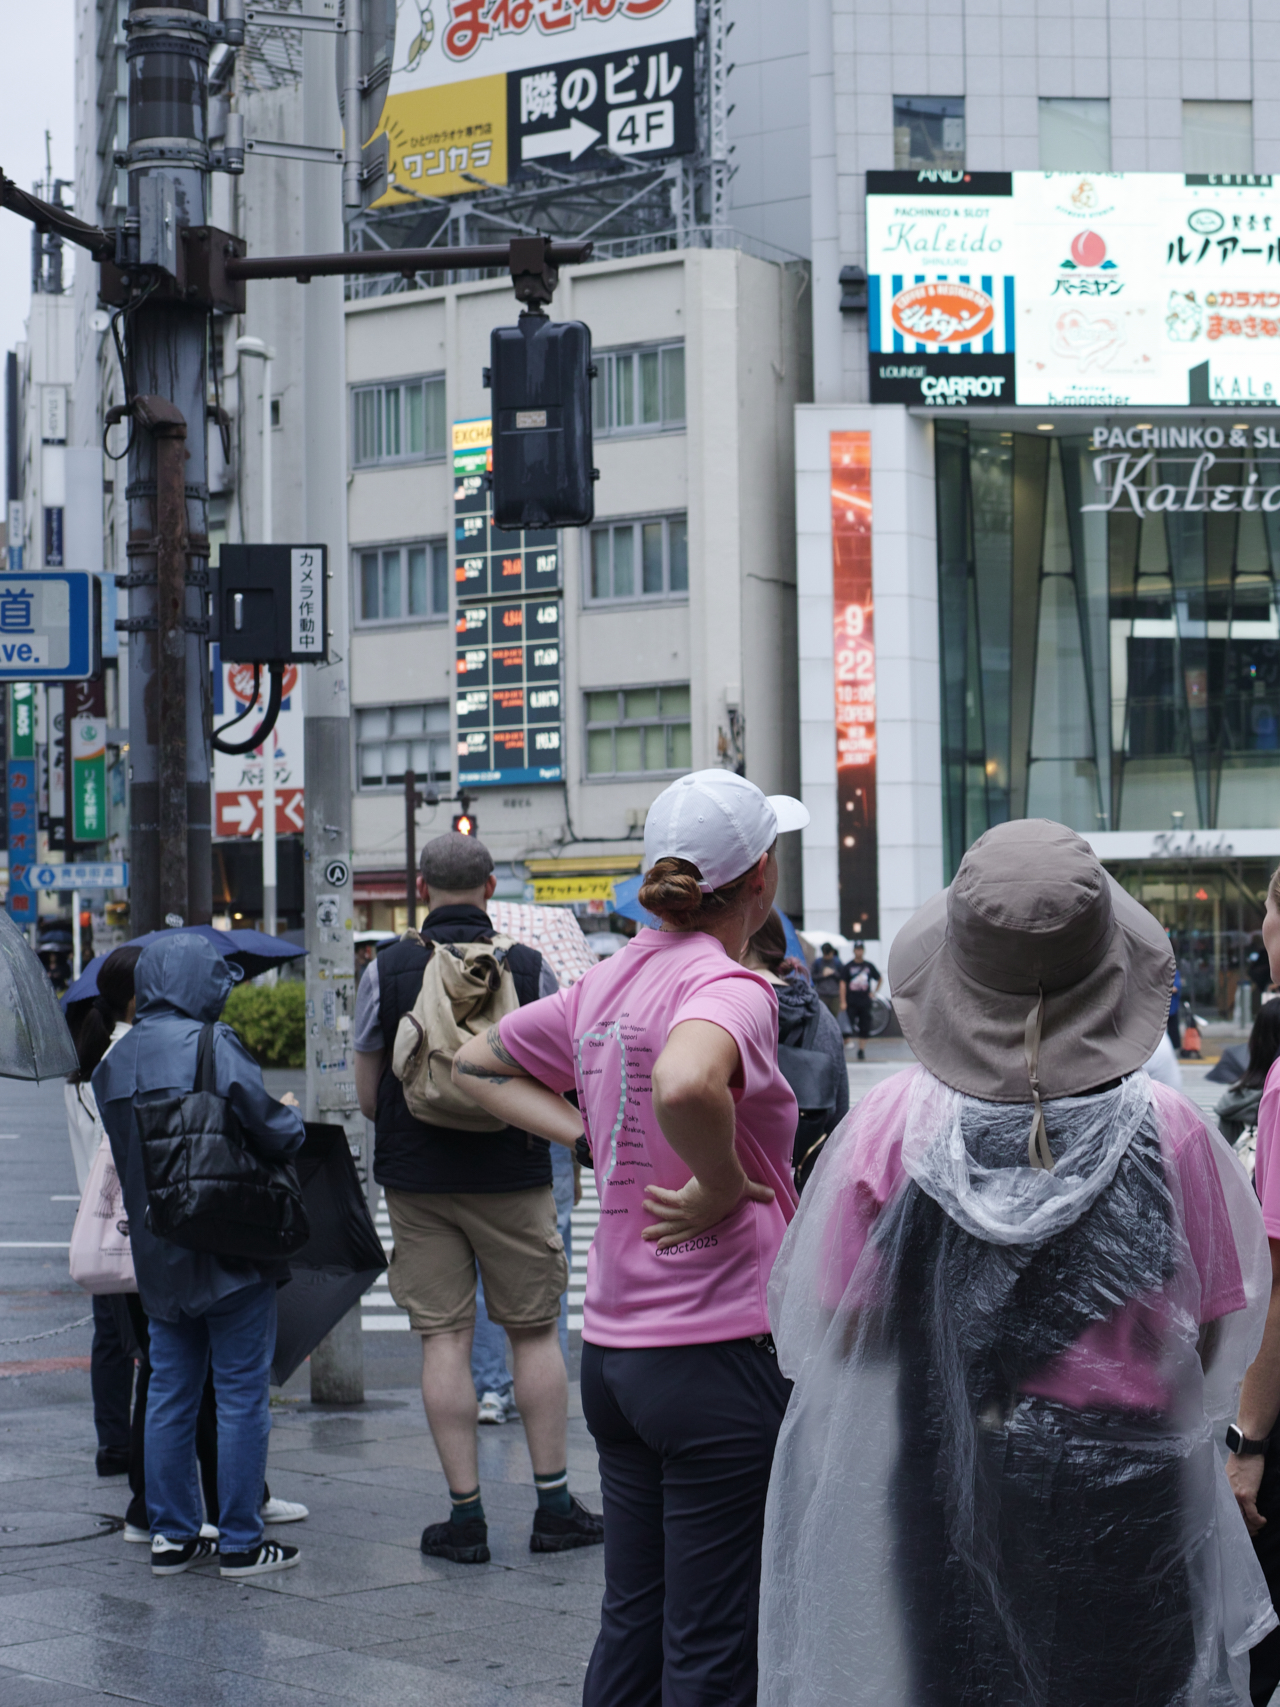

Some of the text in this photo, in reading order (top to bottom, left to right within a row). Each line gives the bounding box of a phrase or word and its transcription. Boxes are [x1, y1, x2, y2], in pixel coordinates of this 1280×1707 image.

[520, 51, 683, 124] 隣のビル
[410, 123, 492, 149] ひとりカラオケ専門店
[617, 110, 666, 146] 4F
[402, 140, 494, 180] ワンカラ
[894, 208, 990, 217] PACHINKO & SLOT
[882, 222, 1003, 254] Kaleido
[1050, 278, 1125, 296] バーミヤン
[879, 365, 926, 378] LOUNGE
[920, 376, 1005, 397] CARROT
[1093, 427, 1224, 448] PACHINKO
[1229, 428, 1247, 448] &
[299, 552, 314, 649] カメラ作動中
[0, 642, 40, 663] ve.
[838, 650, 873, 680] 22
[83, 768, 97, 830] りそな銀行
[11, 773, 29, 911] カラオケ館
[607, 1178, 635, 1186] Tamachi
